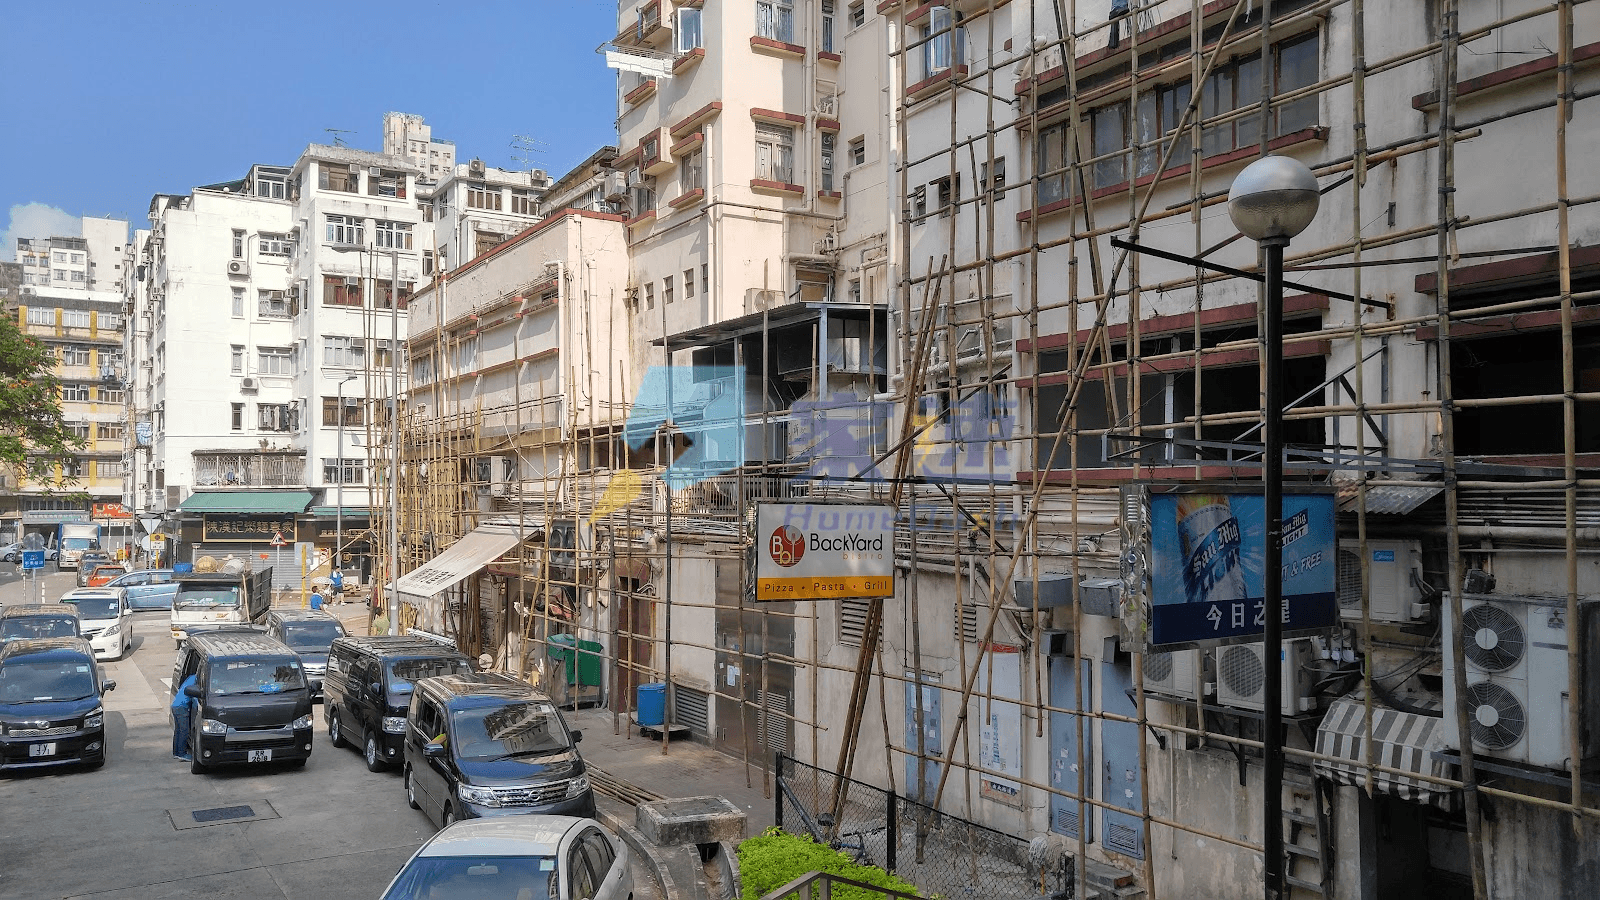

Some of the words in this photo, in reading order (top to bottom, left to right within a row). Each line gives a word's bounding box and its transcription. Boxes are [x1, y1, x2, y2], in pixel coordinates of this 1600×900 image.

[810, 533, 883, 551] BackYard
[1300, 551, 1322, 574] FREE
[764, 583, 794, 593] Pizza
[813, 582, 845, 592] Pasta
[864, 580, 887, 590] Grill
